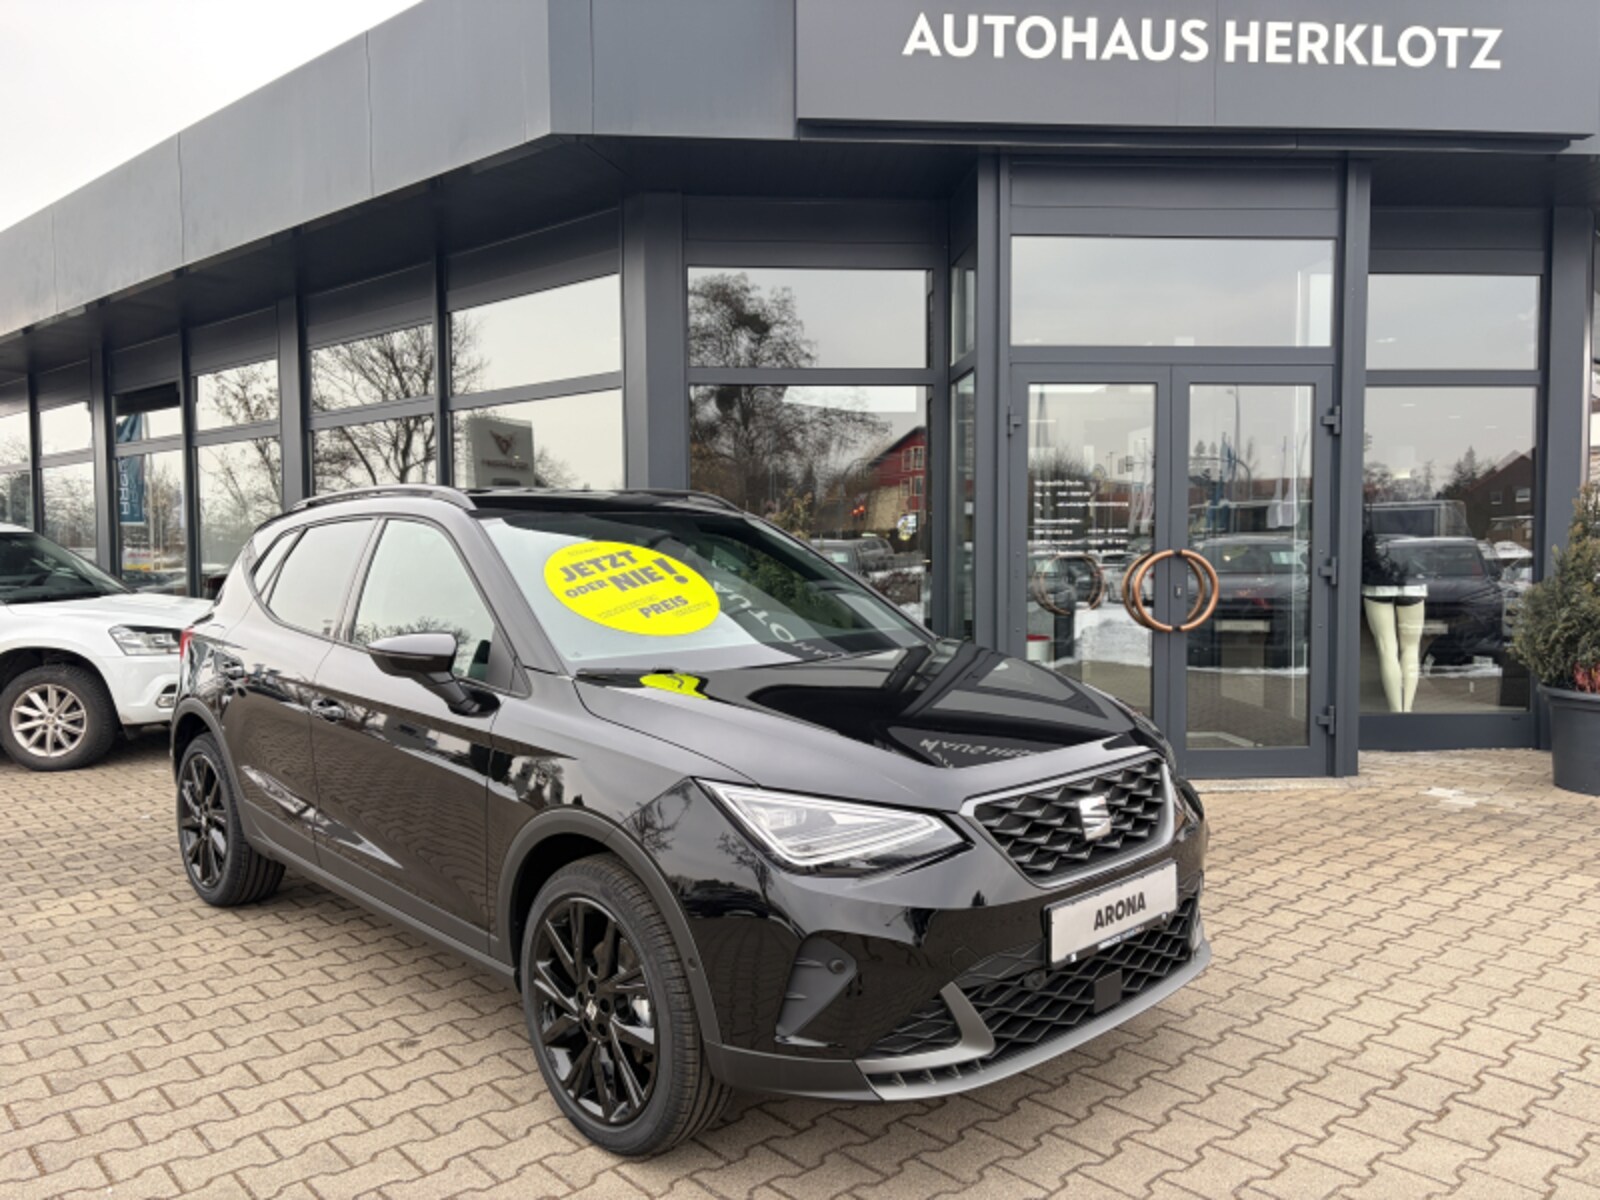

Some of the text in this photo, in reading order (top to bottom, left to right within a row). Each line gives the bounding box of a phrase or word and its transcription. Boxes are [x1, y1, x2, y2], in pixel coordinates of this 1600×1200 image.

[902, 12, 1503, 70] AUTOHAUS HERKLOTZ
[118, 457, 131, 515] UPRA
[559, 550, 638, 582] JETZT
[565, 580, 608, 598] ODER
[639, 595, 689, 618] PREIS
[1093, 891, 1147, 931] ARONA
